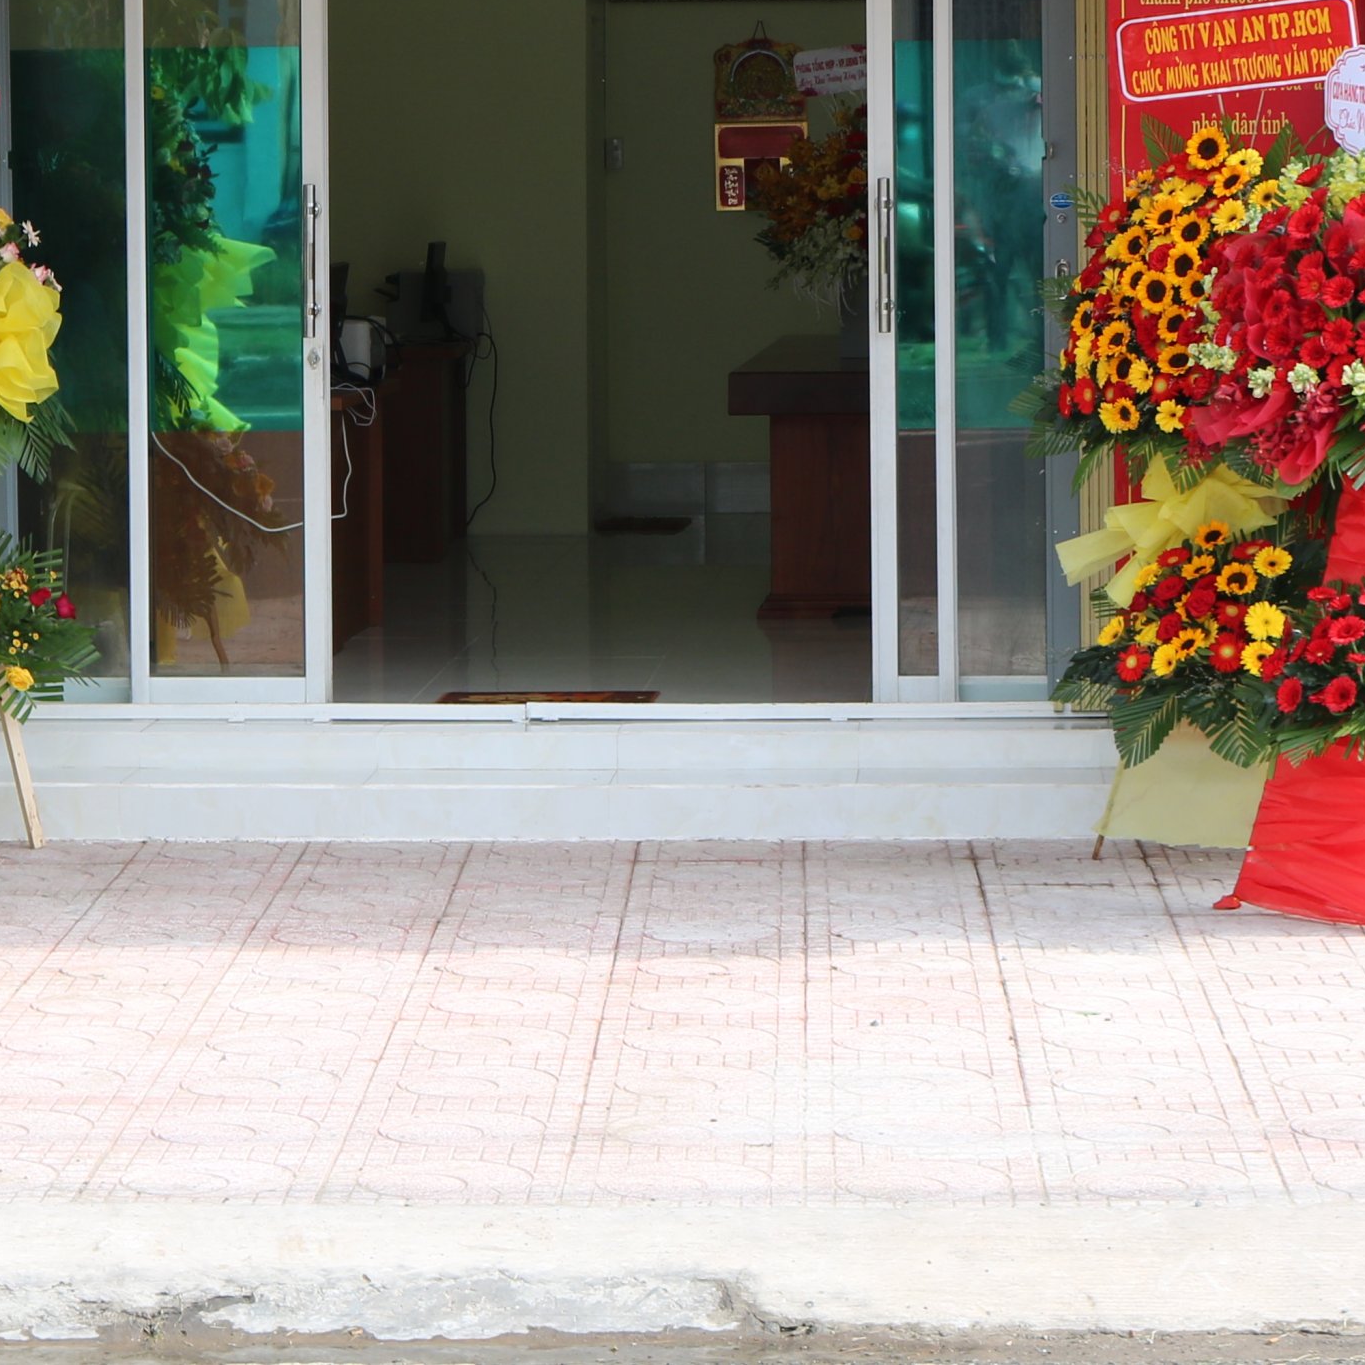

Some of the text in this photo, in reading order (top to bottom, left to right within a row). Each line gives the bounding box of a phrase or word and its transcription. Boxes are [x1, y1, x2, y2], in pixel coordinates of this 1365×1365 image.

[1144, 6, 1332, 55] CÔNG TY VẠN AN TP.HCM
[1132, 59, 1163, 95] CHÚC
[1166, 58, 1199, 90] MỪNG
[1202, 60, 1232, 87] KHAI
[1233, 52, 1281, 82] TRƯƠNG
[1284, 44, 1310, 77] VĂN
[1232, 112, 1258, 135] dân
